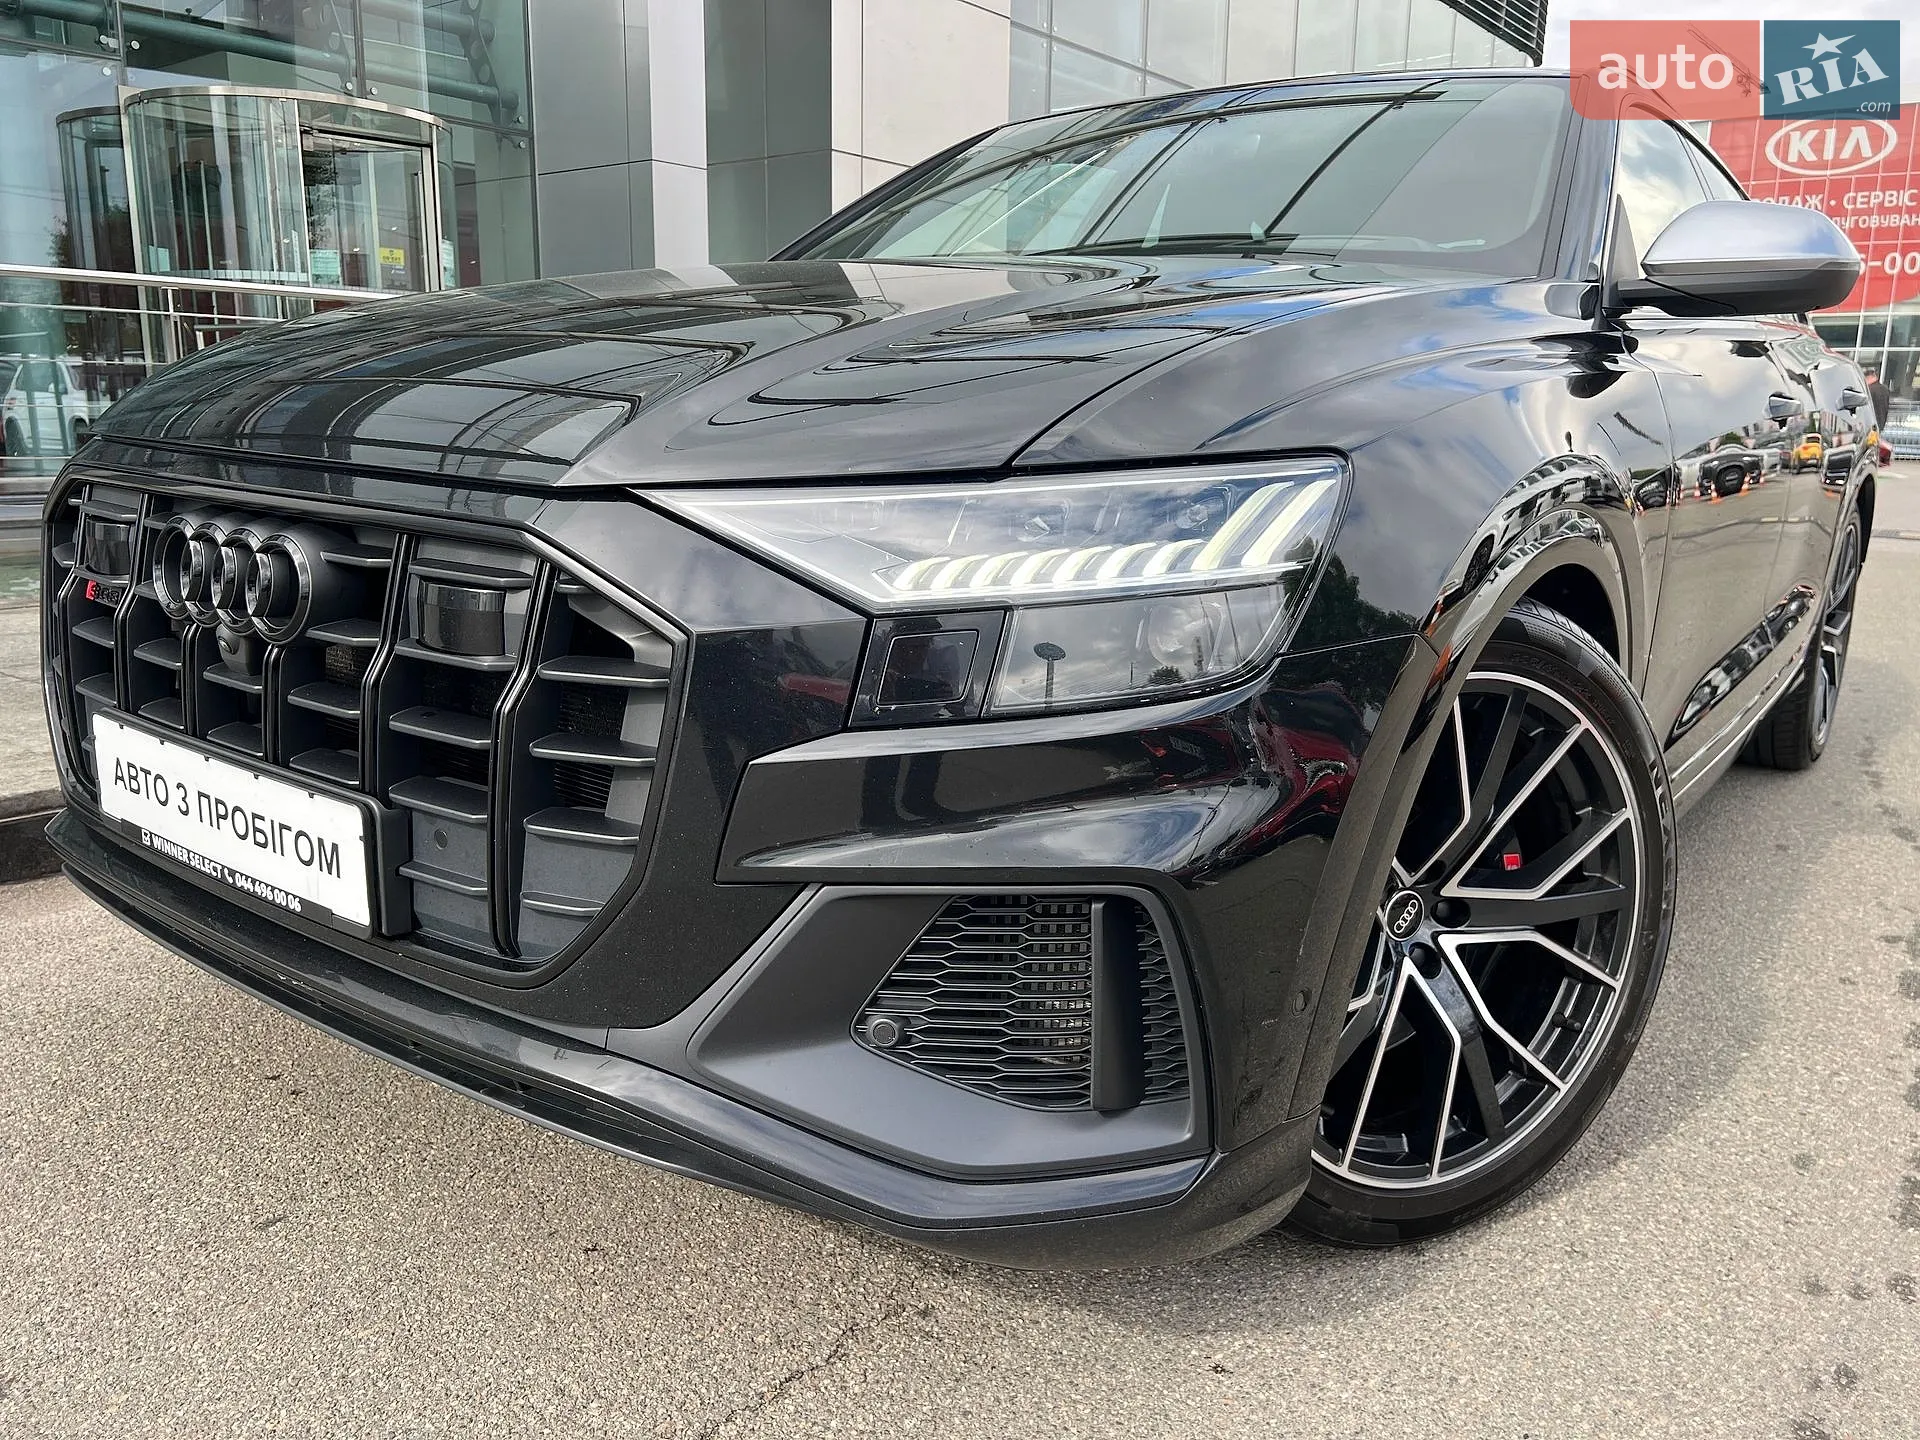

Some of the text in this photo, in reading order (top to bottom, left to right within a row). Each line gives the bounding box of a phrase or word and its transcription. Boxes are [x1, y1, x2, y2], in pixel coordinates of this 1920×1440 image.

[1787, 126, 1873, 163] KIA
[1843, 189, 1918, 210] СЕРВІС
[113, 757, 169, 807] АВТО
[197, 790, 342, 880] ПРОБІГОМ
[151, 833, 302, 913] WINNER SELECT 044 496 00 06
